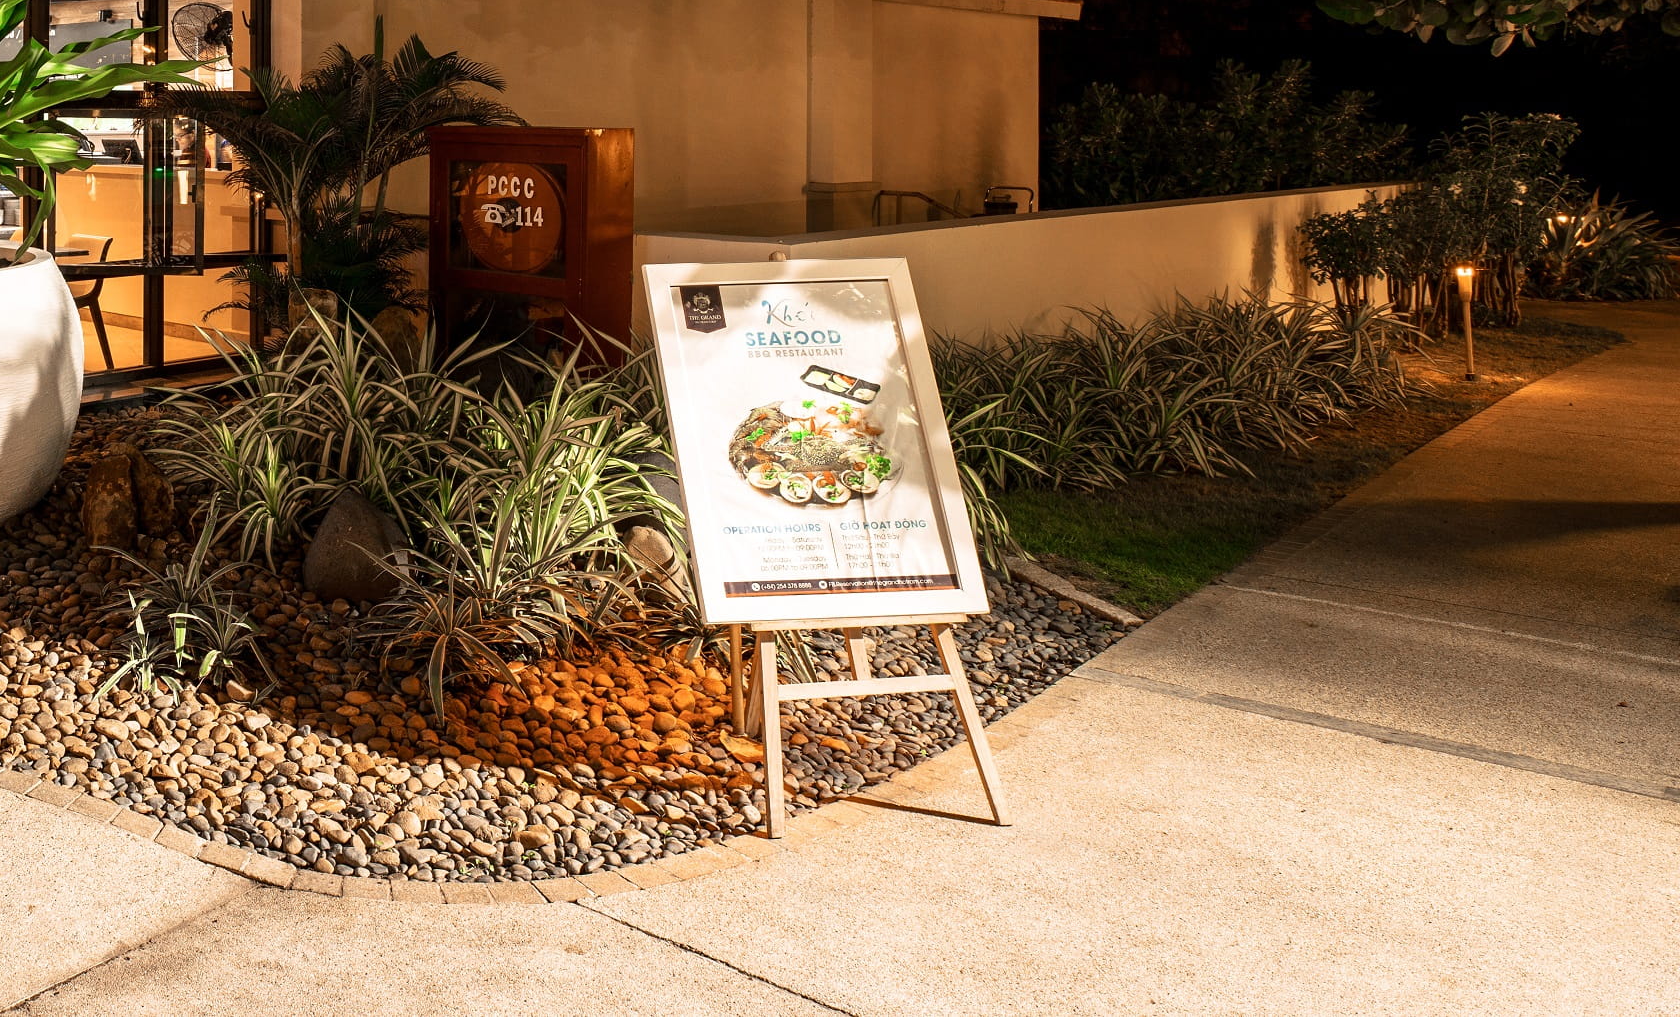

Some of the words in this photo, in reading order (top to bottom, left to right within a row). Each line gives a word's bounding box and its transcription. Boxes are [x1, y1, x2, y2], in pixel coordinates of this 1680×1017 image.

[515, 206, 544, 227] 114
[745, 330, 841, 346] SEAFOOD
[747, 350, 771, 358] BBQ
[775, 348, 844, 357] RESTAURANT
[723, 525, 781, 534] OPERATION
[785, 523, 821, 532] HOURS
